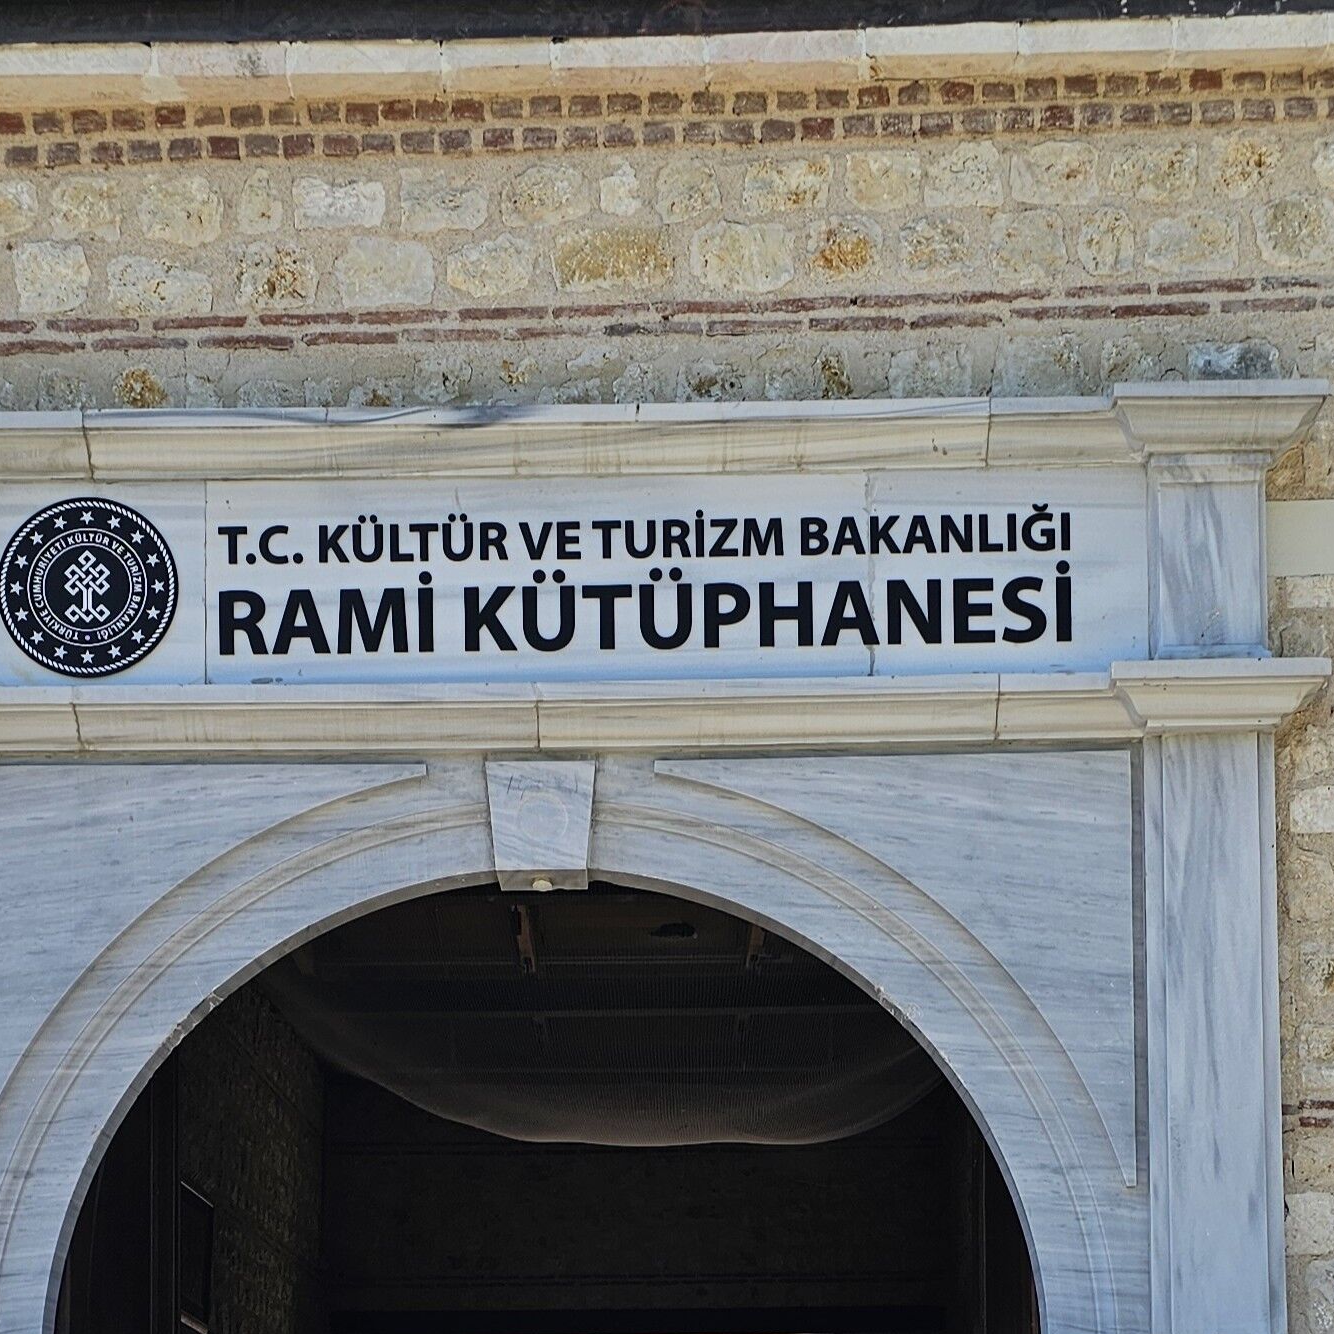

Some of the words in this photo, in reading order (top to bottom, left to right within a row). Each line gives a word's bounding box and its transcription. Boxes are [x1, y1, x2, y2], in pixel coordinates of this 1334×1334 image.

[67, 532, 109, 546] KÜLTÜR
[111, 542, 123, 554] VE
[217, 525, 301, 565] T.C.
[318, 513, 509, 564] KÜLTÜR
[518, 520, 582, 561] VE
[591, 509, 785, 559] TURİZM
[800, 503, 1071, 557] BAKANLIĞI
[32, 538, 66, 608] CUMHURİYETİ
[123, 550, 142, 593] TURİZM
[39, 609, 79, 642] TÜRKİYE
[98, 595, 142, 641] BAKANLIĞI
[218, 569, 435, 656] RAMİ
[463, 560, 1072, 653] KÜTÜPHANESİ
